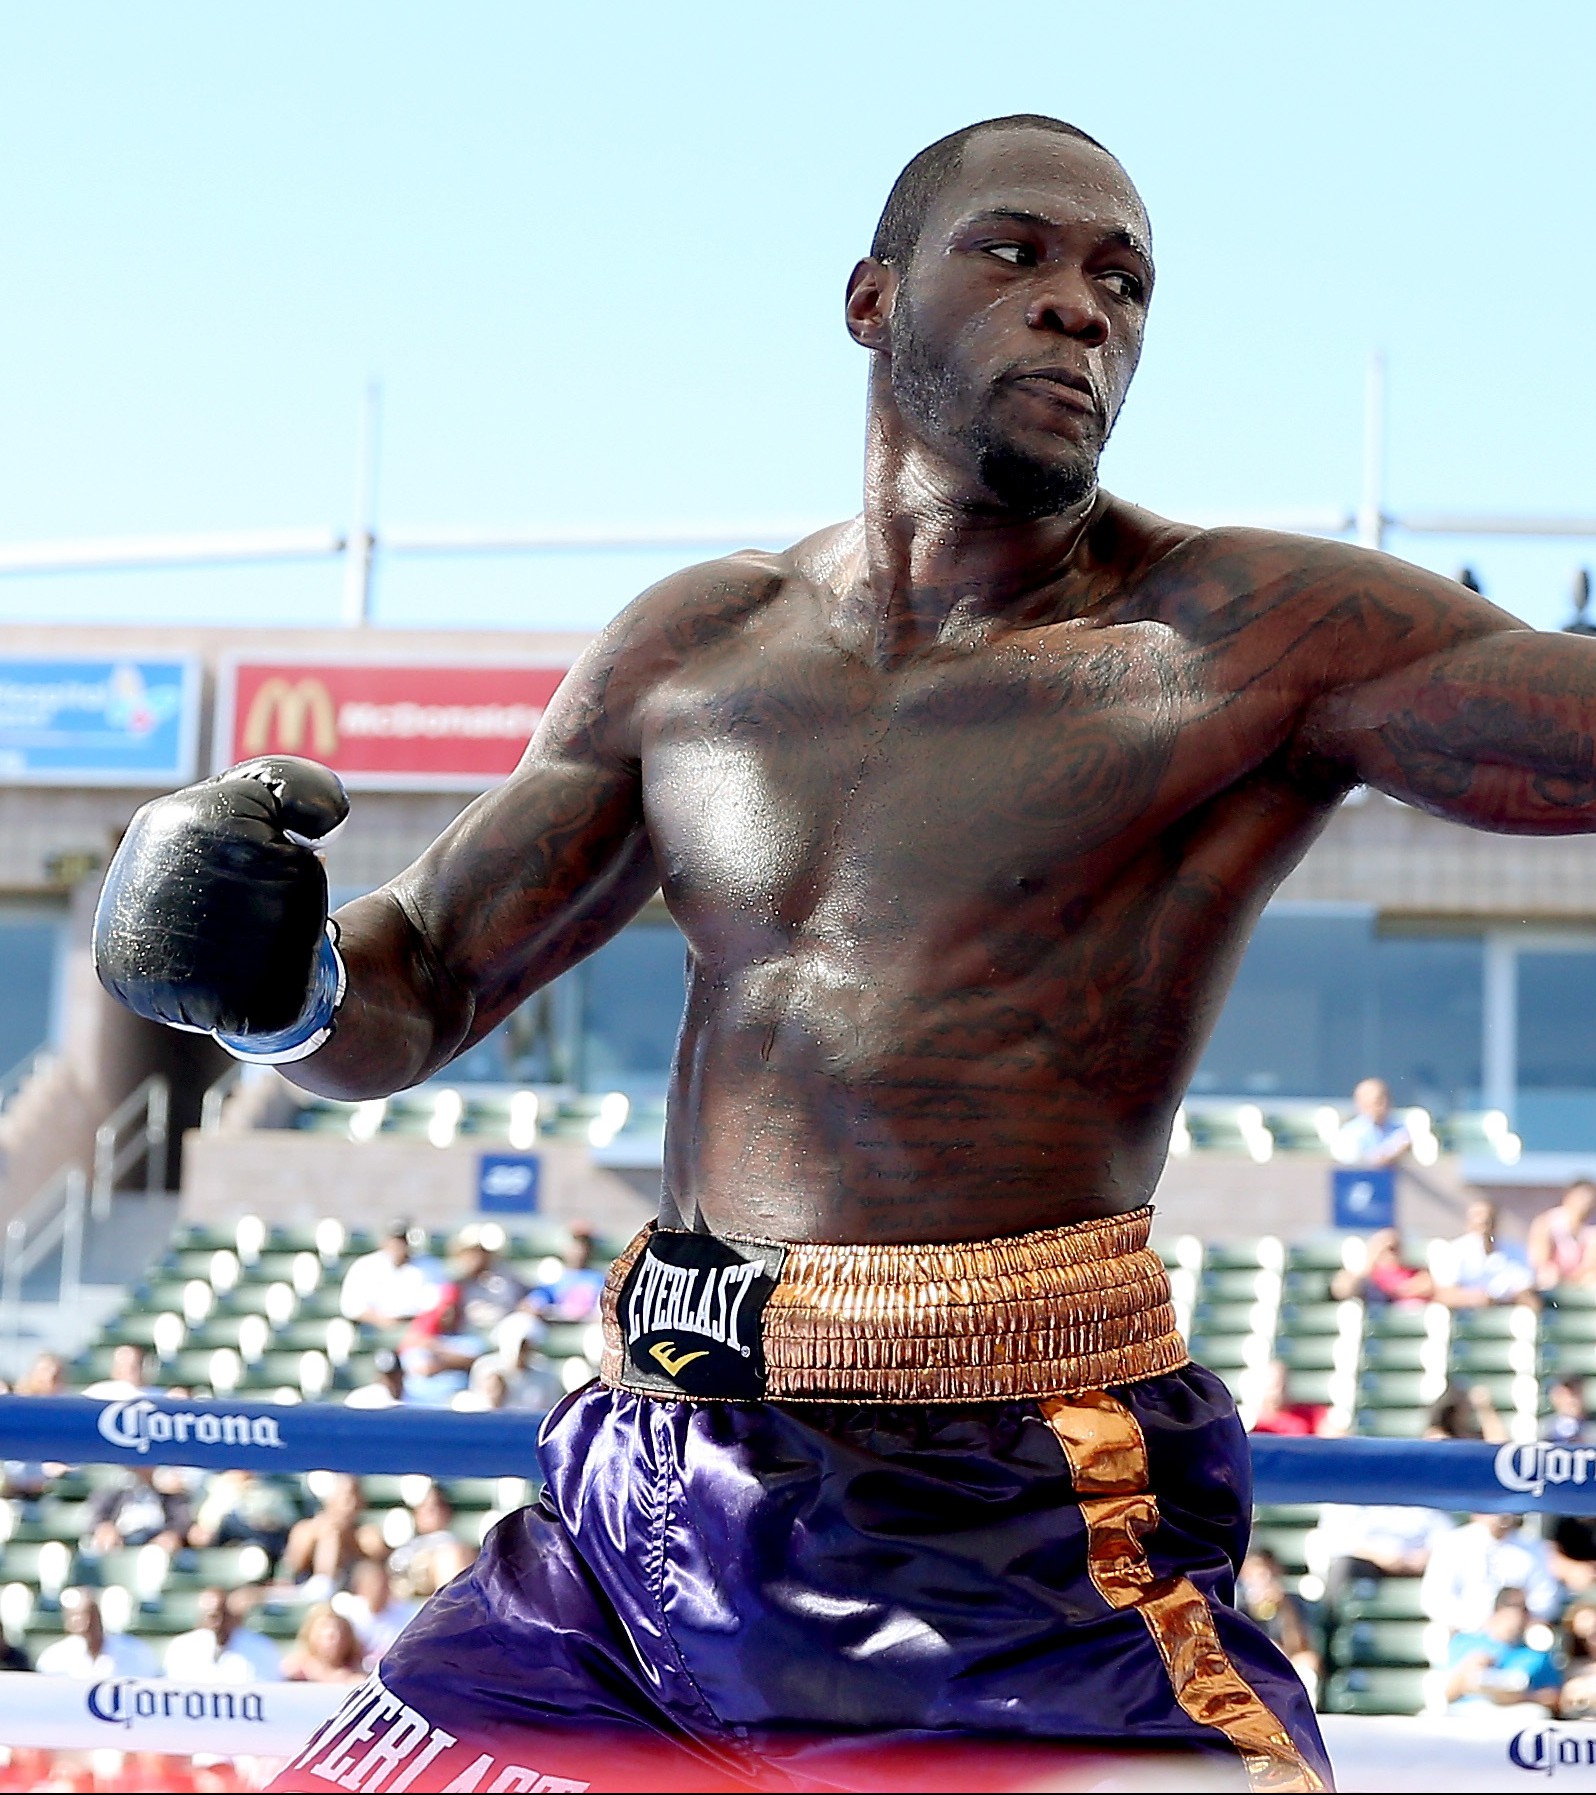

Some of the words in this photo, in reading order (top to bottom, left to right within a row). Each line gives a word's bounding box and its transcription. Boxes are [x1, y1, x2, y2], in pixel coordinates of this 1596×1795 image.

[628, 1247, 767, 1352] EVERLAST
[97, 1400, 287, 1455] Corona
[87, 1678, 267, 1730] Corona
